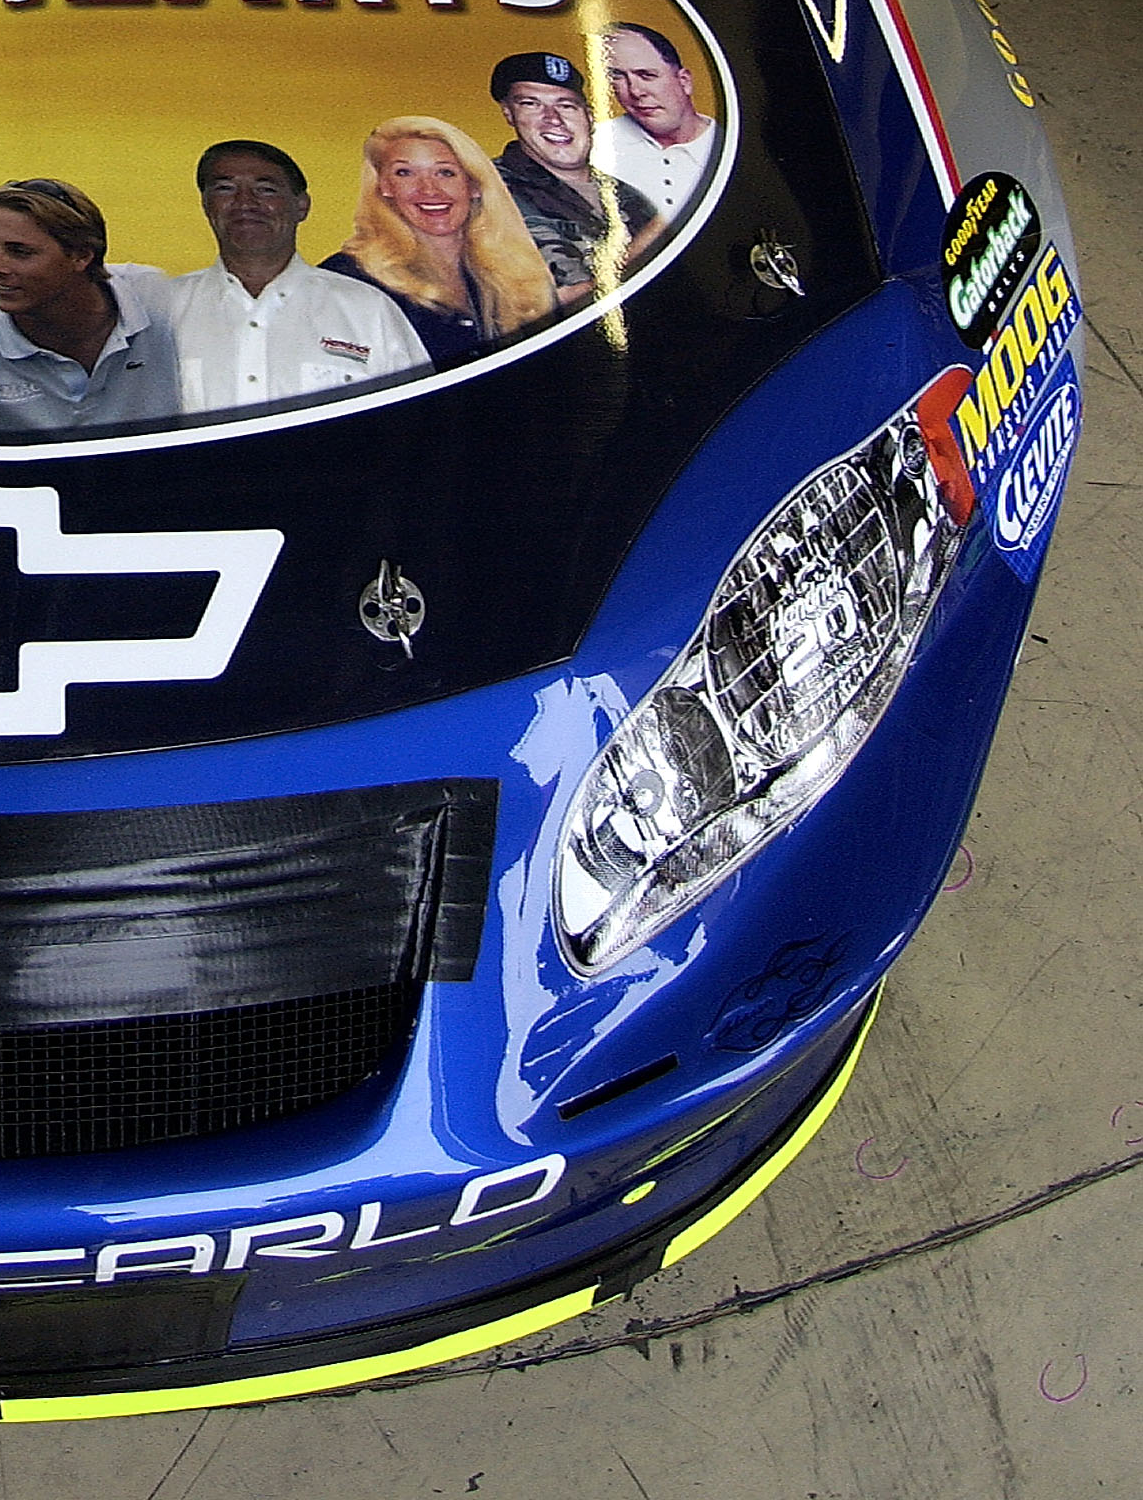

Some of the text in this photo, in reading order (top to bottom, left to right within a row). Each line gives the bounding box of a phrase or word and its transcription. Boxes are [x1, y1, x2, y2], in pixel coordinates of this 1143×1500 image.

[943, 178, 999, 268] GOODYEAR
[948, 190, 1033, 331] Gatorback
[956, 247, 1072, 470] MOOG
[997, 385, 1077, 544] CLEVITE
